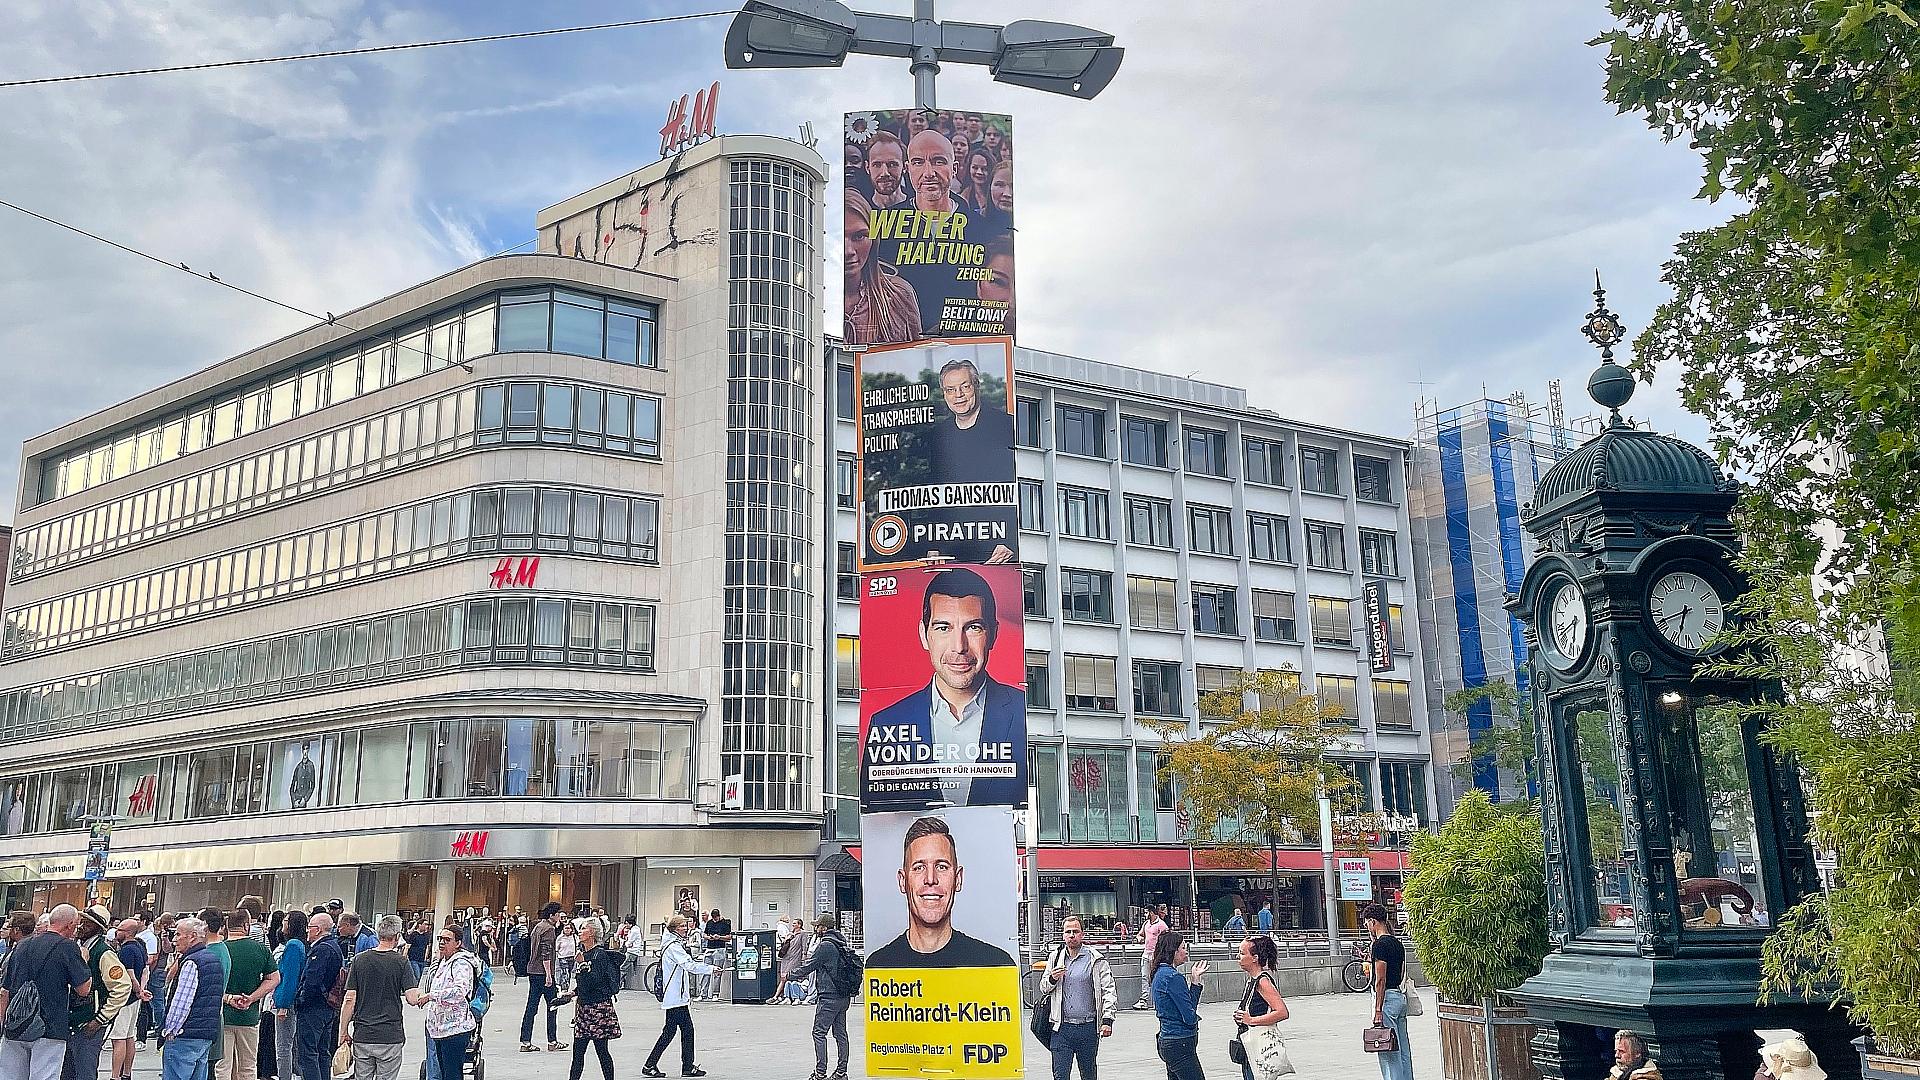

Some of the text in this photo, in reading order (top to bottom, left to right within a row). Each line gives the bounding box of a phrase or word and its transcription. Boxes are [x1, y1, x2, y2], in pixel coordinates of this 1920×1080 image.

[659, 81, 720, 155] H&M
[868, 210, 967, 240] WEITER
[896, 242, 984, 266] HALTUNG
[957, 267, 995, 281] ZEIGEN.
[942, 306, 1008, 321] BELIT ONAY
[940, 319, 1006, 333] FÜR HANNOVER.
[864, 384, 929, 408] EHRLICHE UND
[864, 407, 935, 430] TRANSPARENTE
[865, 434, 899, 454] POLITIK
[883, 485, 1015, 511] THOMAS GANSKOW
[914, 521, 1006, 542] PIRATEN
[489, 556, 540, 589] H&M
[870, 577, 897, 591] SPD
[1367, 585, 1384, 669] Hugendubel
[868, 724, 922, 744] AXEL
[868, 742, 1012, 763] VON DER OHE
[872, 765, 1013, 776] OBERBÜRGERMEISTER FÜR HANNOVER
[868, 781, 961, 792] FÜR DIE GANZE STADT
[451, 831, 489, 858] H&M
[870, 979, 923, 998] Robert
[870, 1002, 1011, 1022] Reinhardt-Klein
[870, 1043, 953, 1056] Regionsliste Platz 1
[963, 1044, 1008, 1064] FDP
